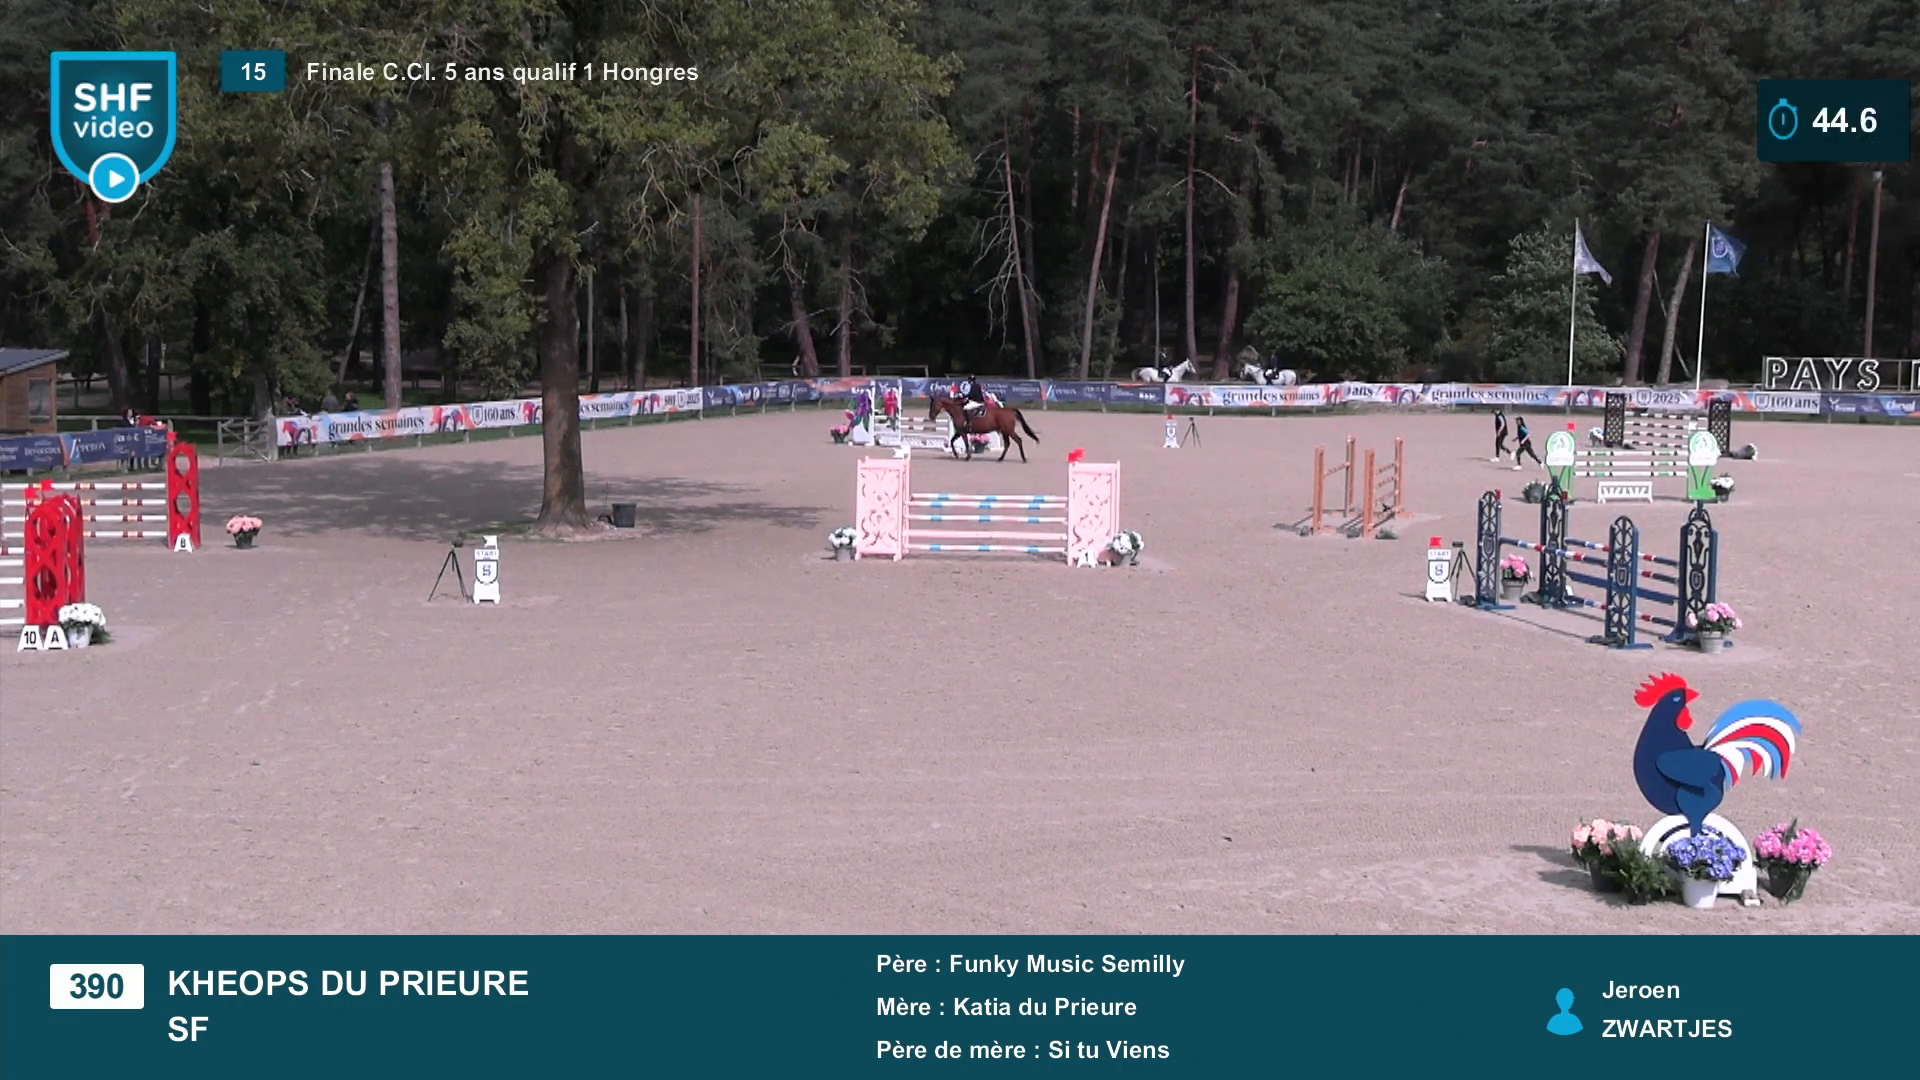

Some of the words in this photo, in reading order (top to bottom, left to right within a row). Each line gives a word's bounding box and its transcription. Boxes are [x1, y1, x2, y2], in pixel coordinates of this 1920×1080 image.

[1765, 356, 1881, 392] PAYS
[1222, 385, 1278, 404] grandes
[1279, 385, 1320, 401] semaines
[1431, 387, 1486, 403] grandes
[1487, 387, 1549, 401] semaines
[1652, 393, 1681, 404] 2025
[328, 414, 372, 438] grandes
[375, 414, 424, 432] semaines
[1084, 551, 1089, 562] 1
[24, 631, 37, 645] 10
[50, 631, 60, 643] A
